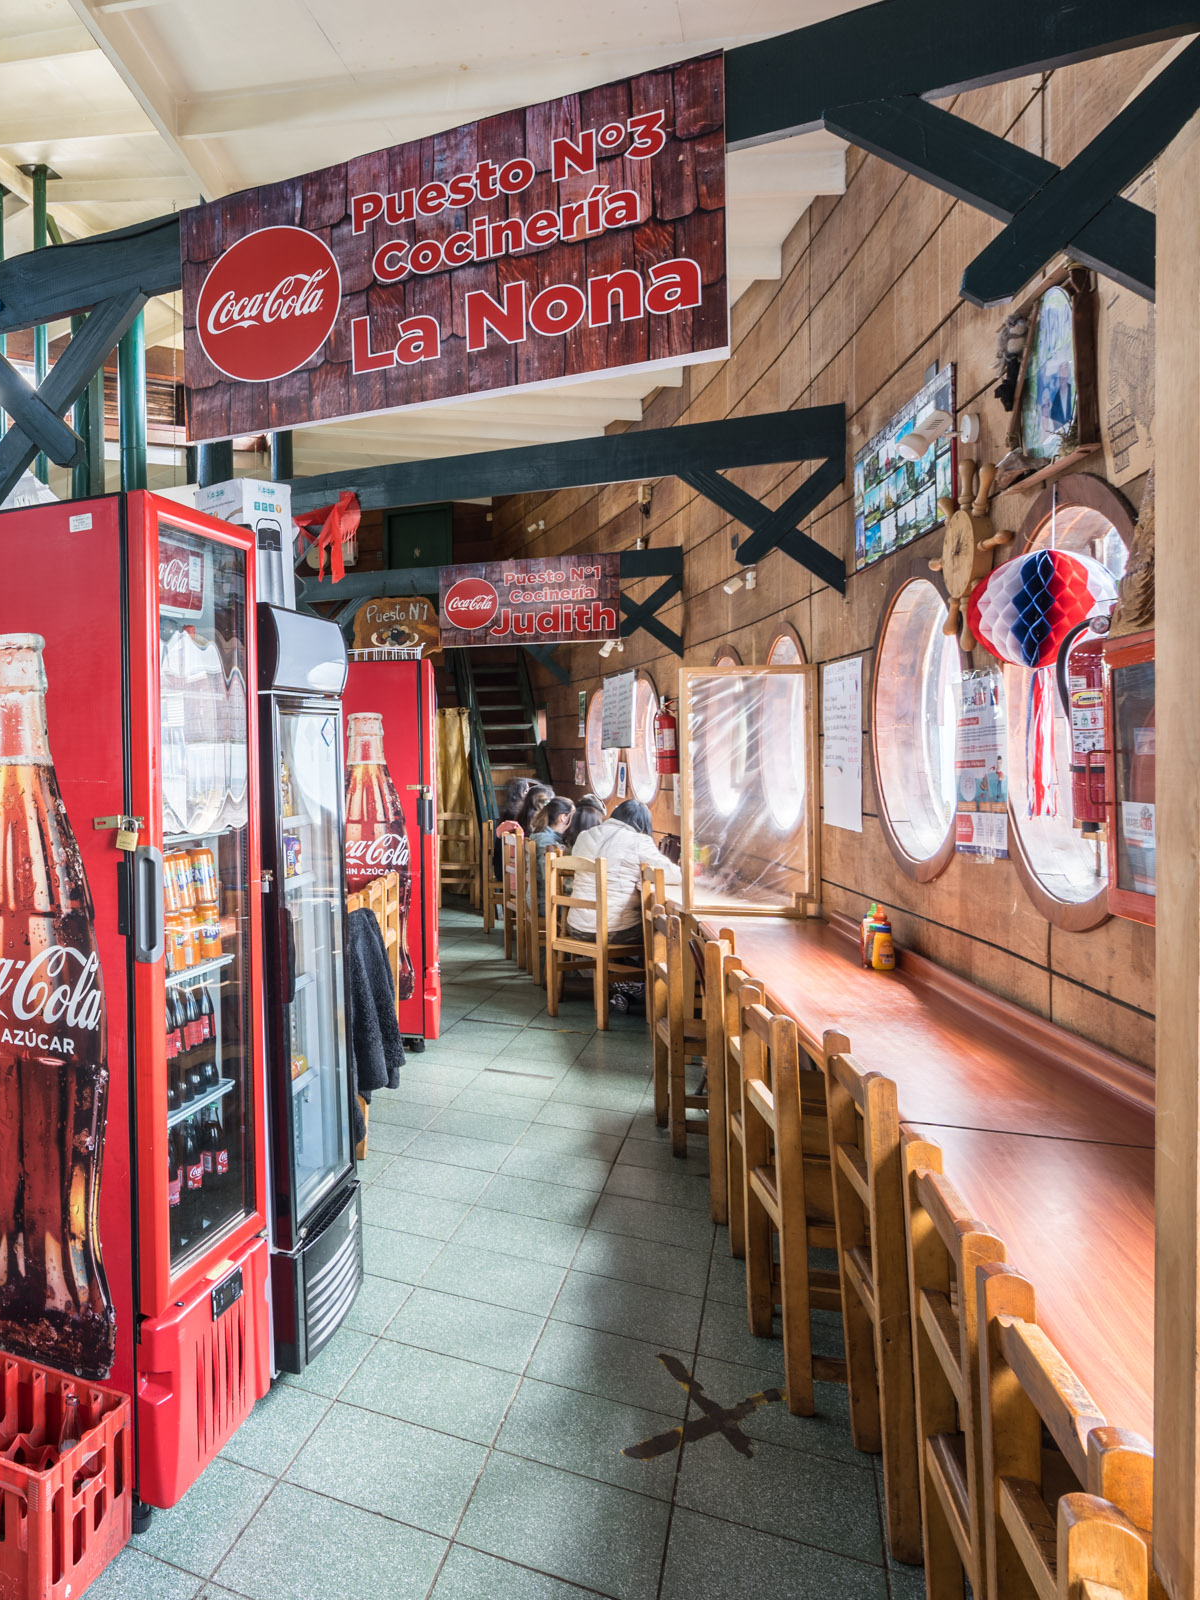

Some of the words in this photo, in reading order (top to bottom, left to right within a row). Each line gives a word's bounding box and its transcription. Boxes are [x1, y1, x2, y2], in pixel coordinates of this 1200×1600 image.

[352, 158, 535, 235] Puesto
[373, 185, 640, 282] Cocinería
[207, 266, 331, 334] Coca-Cola
[351, 315, 441, 375] La
[465, 258, 702, 352] Nona
[504, 570, 565, 586] Puesto
[448, 594, 495, 612] Coca-Cola
[509, 584, 596, 603] Cocinería
[366, 604, 406, 624] Puesto
[490, 602, 616, 636] Judith
[1, 1028, 75, 1055] AZÚCAR
